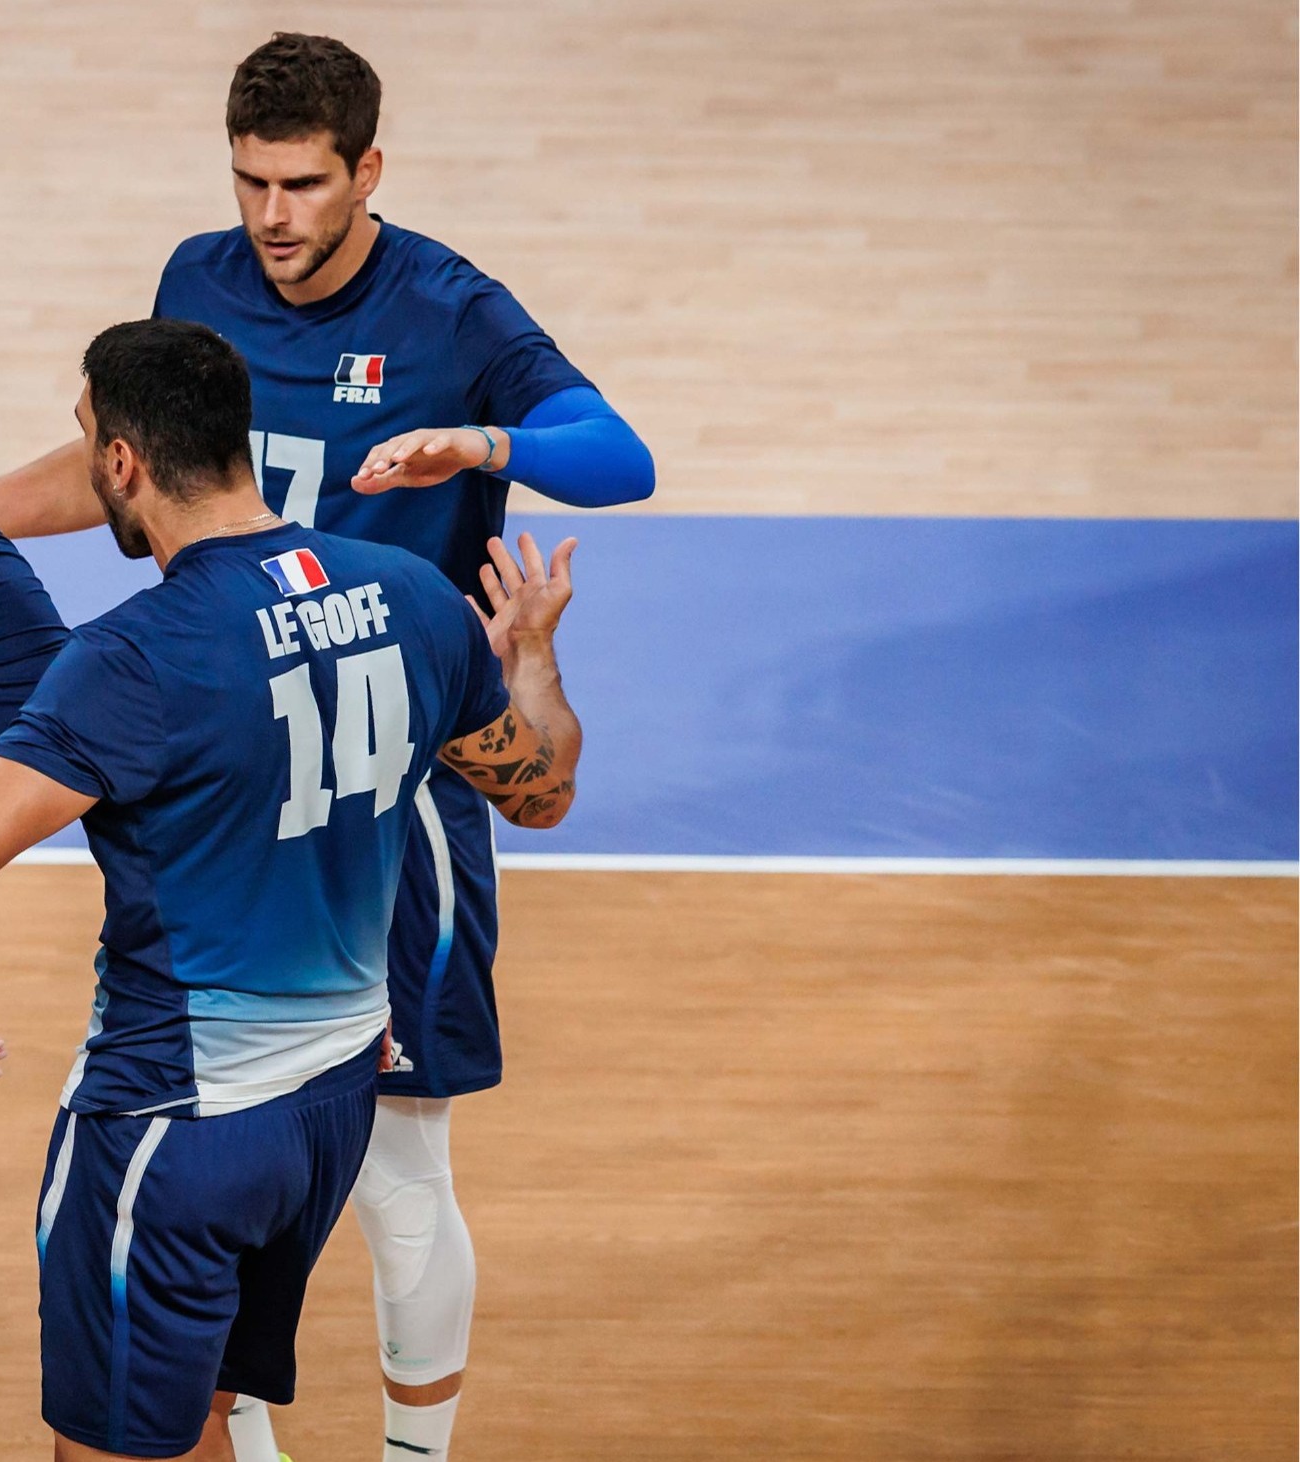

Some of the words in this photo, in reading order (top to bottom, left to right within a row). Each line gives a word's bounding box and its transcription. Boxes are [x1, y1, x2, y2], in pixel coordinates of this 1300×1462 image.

[332, 385, 381, 404] FRA
[255, 601, 301, 659] LE
[295, 581, 391, 651] GOFF
[268, 643, 415, 841] 14
